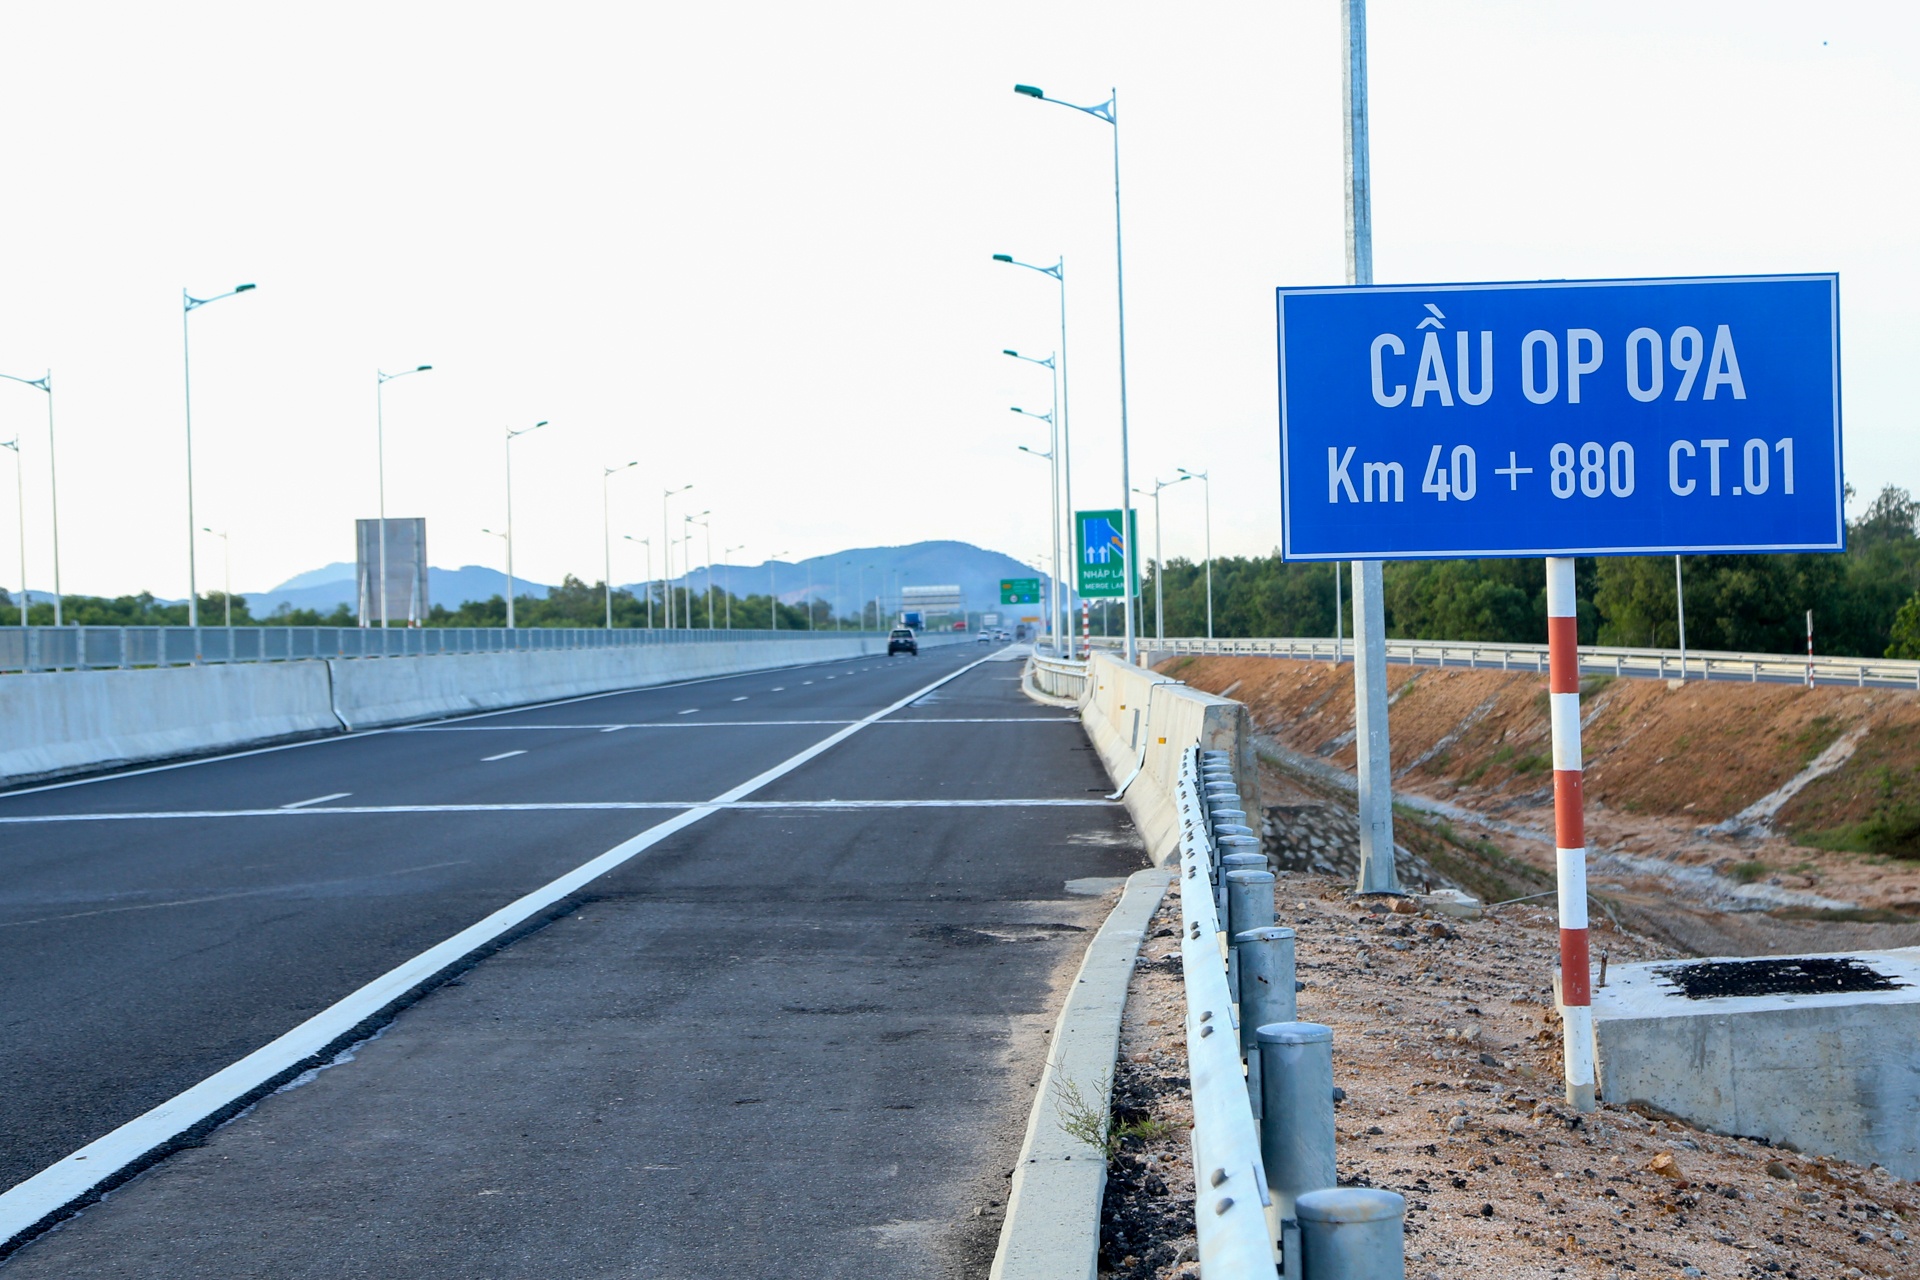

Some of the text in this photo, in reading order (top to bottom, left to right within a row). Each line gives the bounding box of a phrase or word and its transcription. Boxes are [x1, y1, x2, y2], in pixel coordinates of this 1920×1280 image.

[1370, 303, 1747, 408] CẦU OP 09A
[1328, 437, 1794, 503] Km 40 + 880 CT.01
[1085, 582, 1109, 590] MERGE
